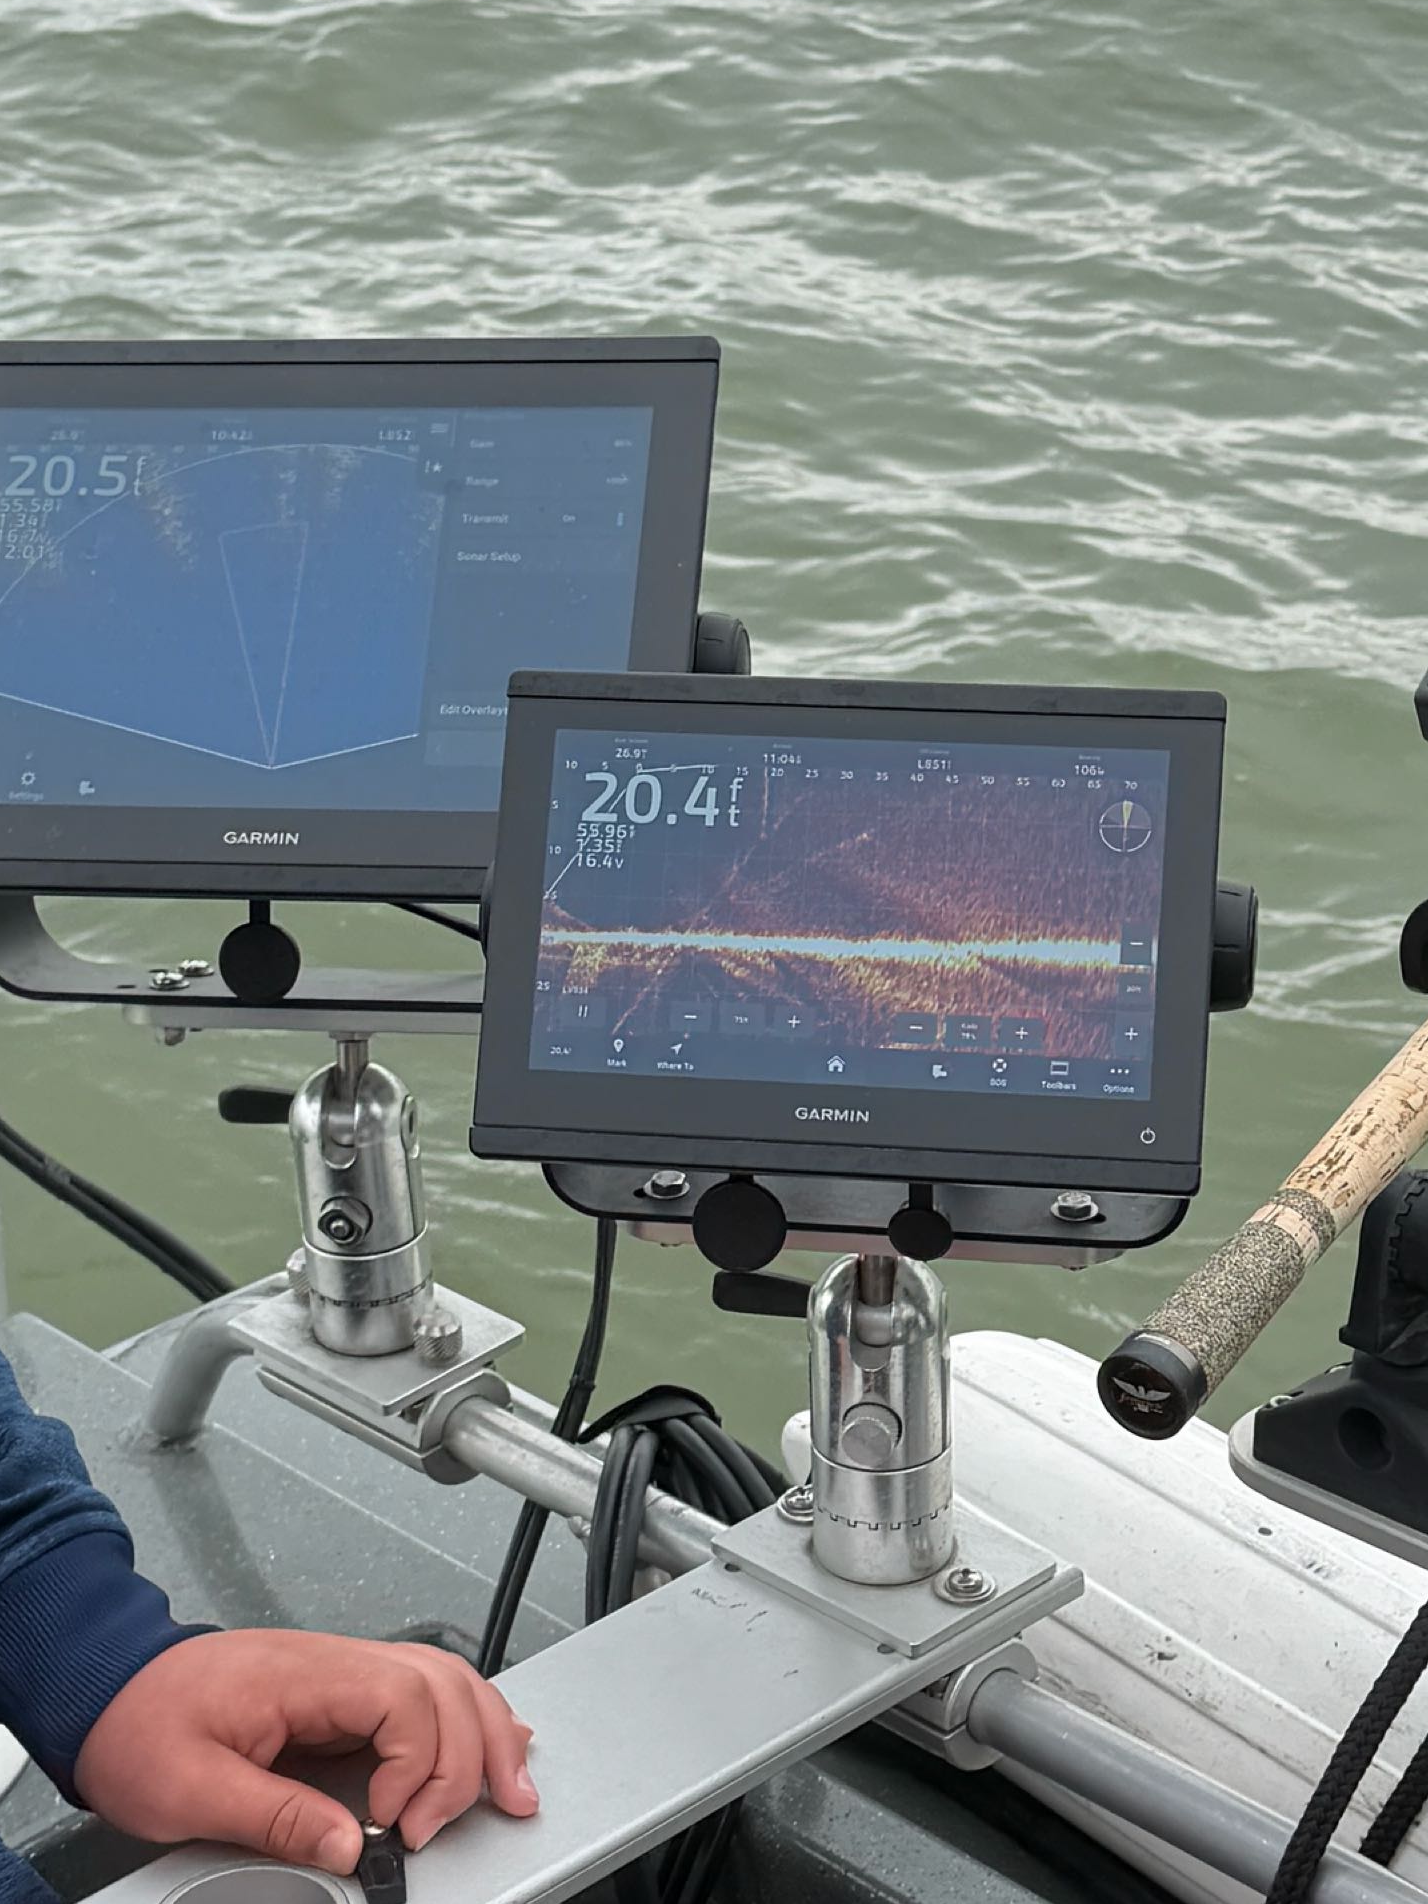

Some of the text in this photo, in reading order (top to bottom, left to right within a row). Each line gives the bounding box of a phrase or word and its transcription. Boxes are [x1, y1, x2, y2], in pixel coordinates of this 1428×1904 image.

[4, 455, 127, 496] 20.5
[462, 514, 509, 524] Transmit
[457, 551, 521, 564] Sonar Setup
[439, 704, 460, 714] Edit
[581, 771, 720, 827] 20.4
[222, 831, 299, 845] GARMIN
[536, 981, 551, 991] 25
[606, 1058, 627, 1068] Mark
[657, 1062, 694, 1071] Where To
[1041, 1080, 1077, 1091] Toolbars
[1103, 1083, 1135, 1094] Options
[794, 1107, 870, 1123] GARMIN
